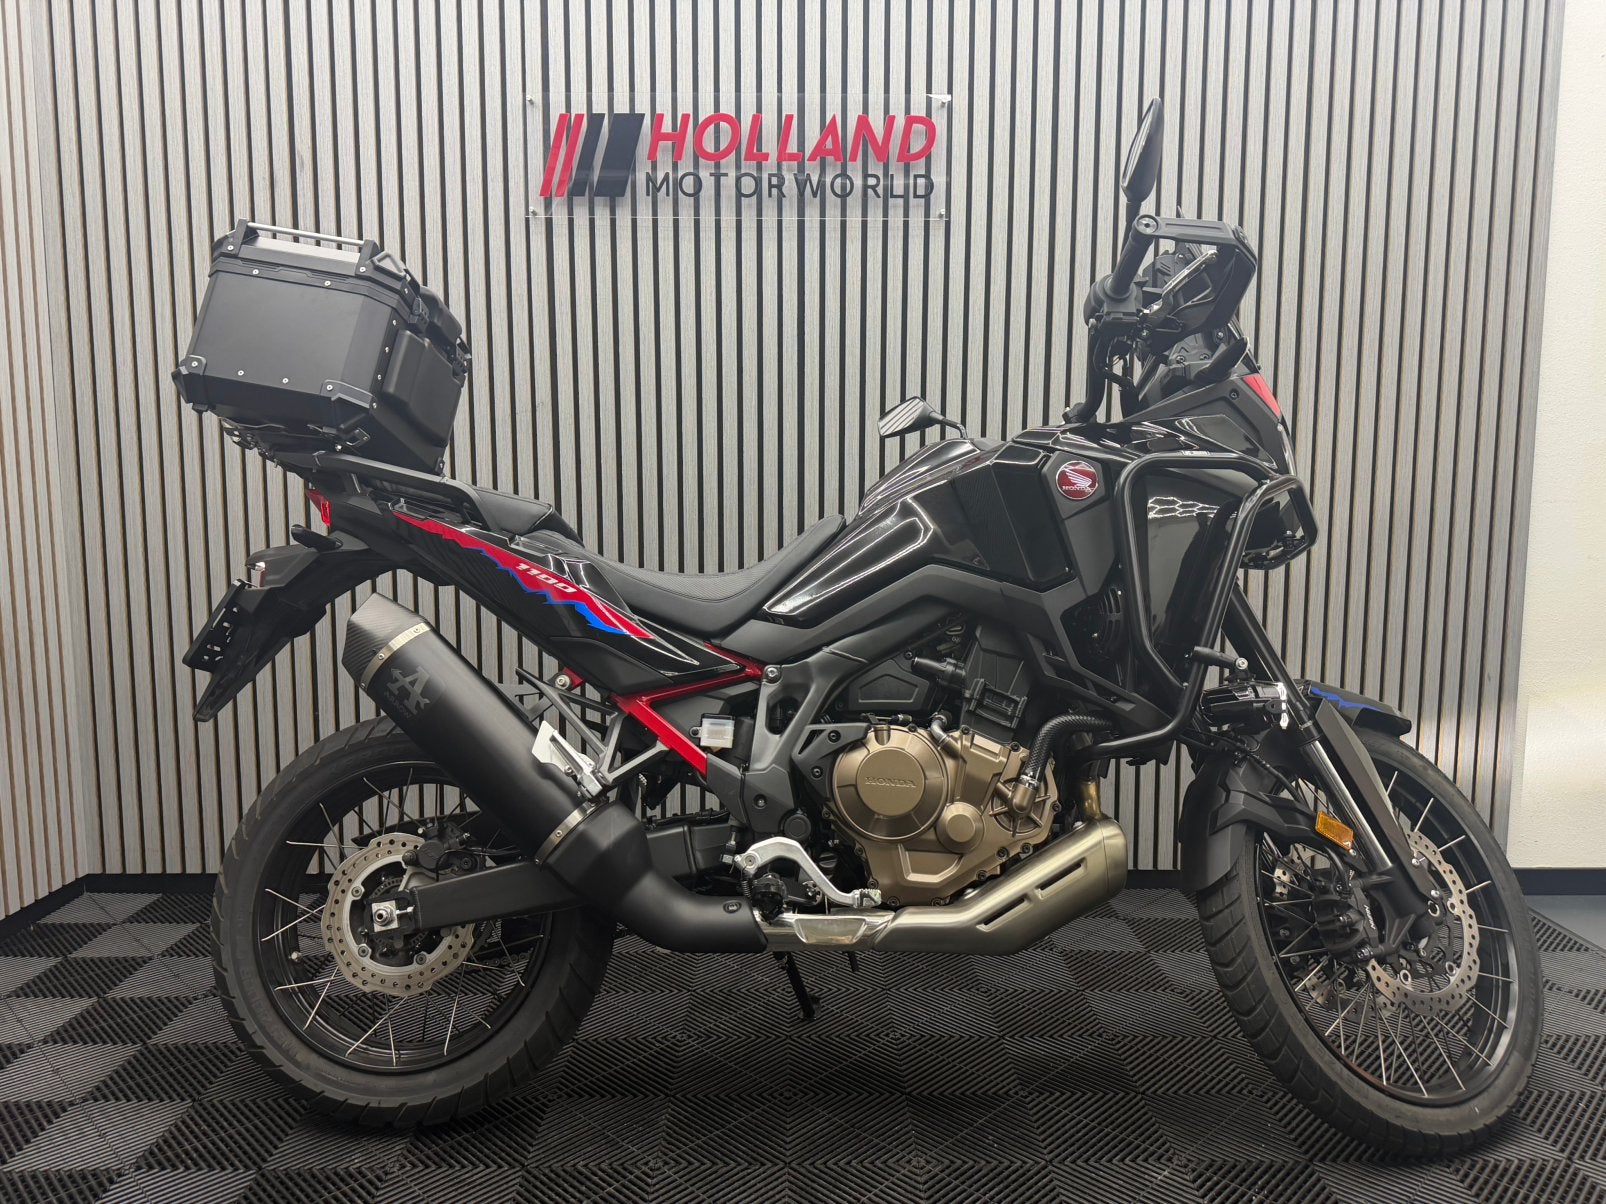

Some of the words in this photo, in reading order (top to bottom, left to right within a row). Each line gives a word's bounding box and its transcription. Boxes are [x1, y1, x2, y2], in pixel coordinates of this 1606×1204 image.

[647, 113, 937, 163] HOLLAND
[645, 172, 935, 199] MOTORWORLD
[515, 562, 578, 593] 1100
[865, 776, 917, 788] HONDA
